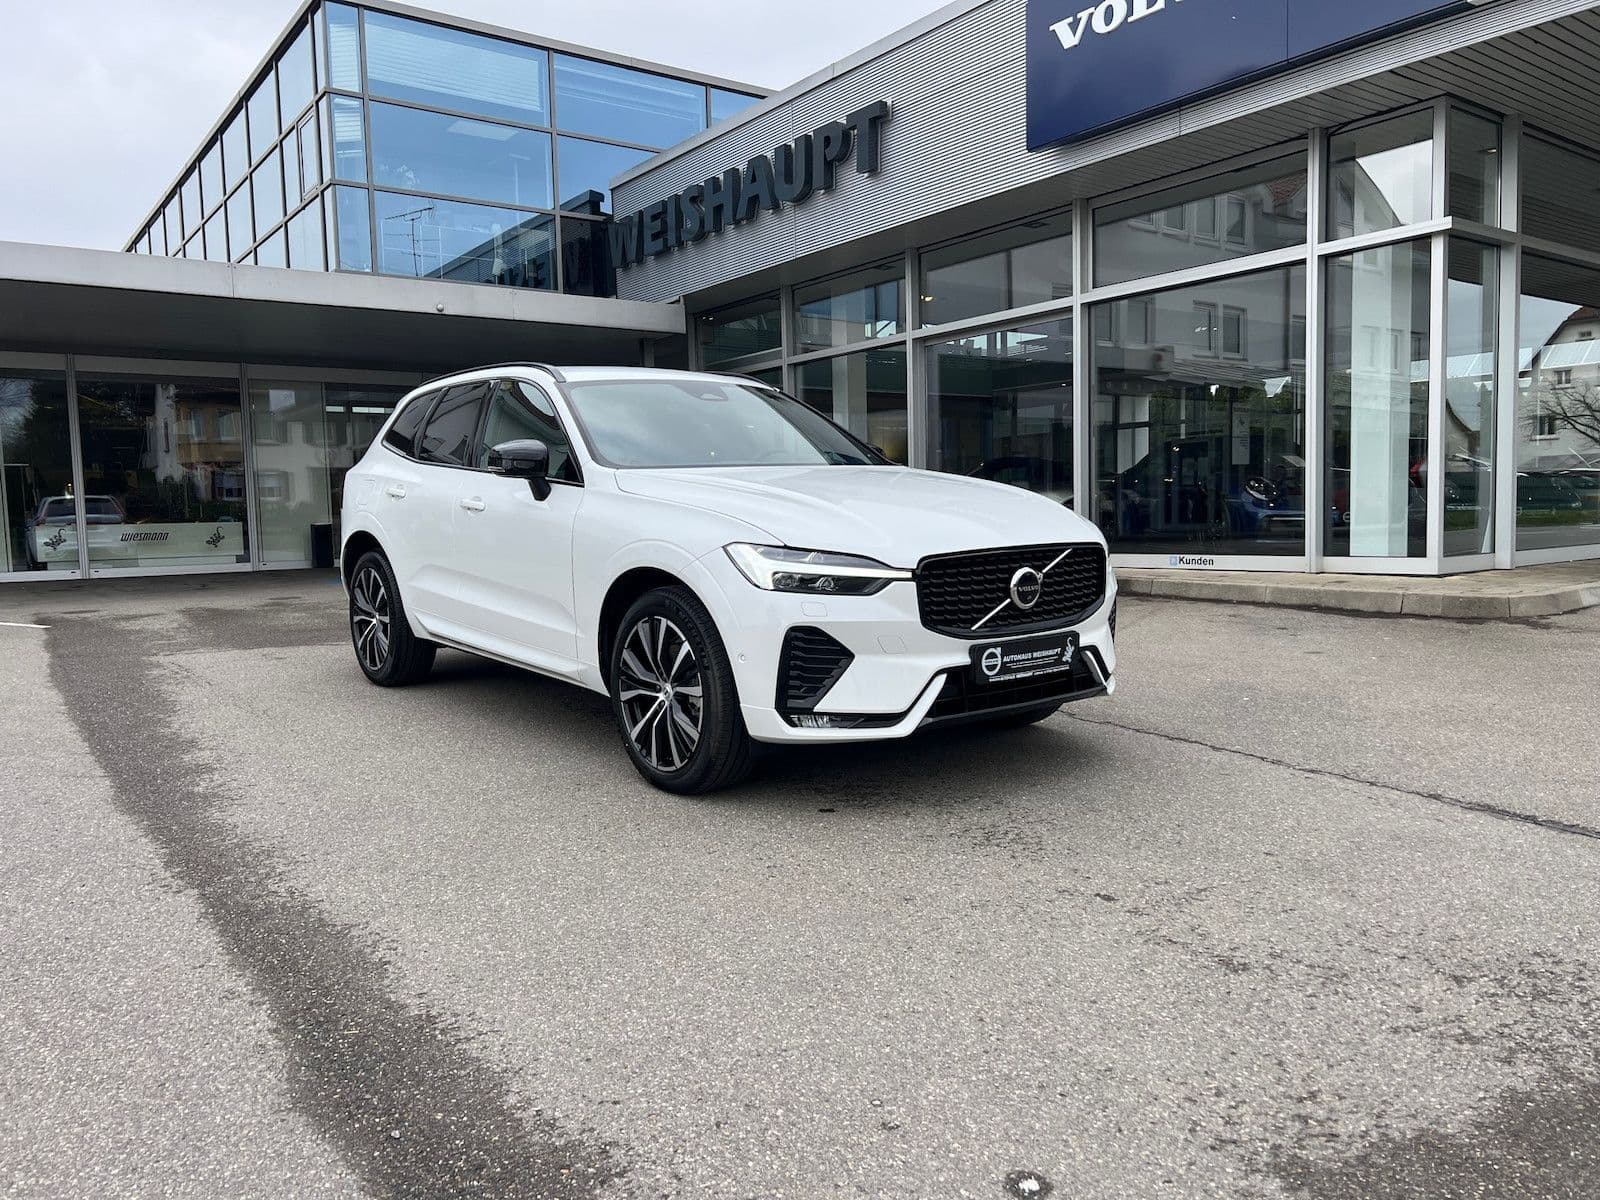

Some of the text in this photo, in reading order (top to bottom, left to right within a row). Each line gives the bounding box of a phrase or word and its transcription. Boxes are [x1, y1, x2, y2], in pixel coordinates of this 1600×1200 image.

[1049, 0, 1184, 49] VOL
[607, 100, 889, 268] WEISHAUPT
[1179, 556, 1214, 565] Kunden
[1003, 653, 1032, 662] AUTOHAUS
